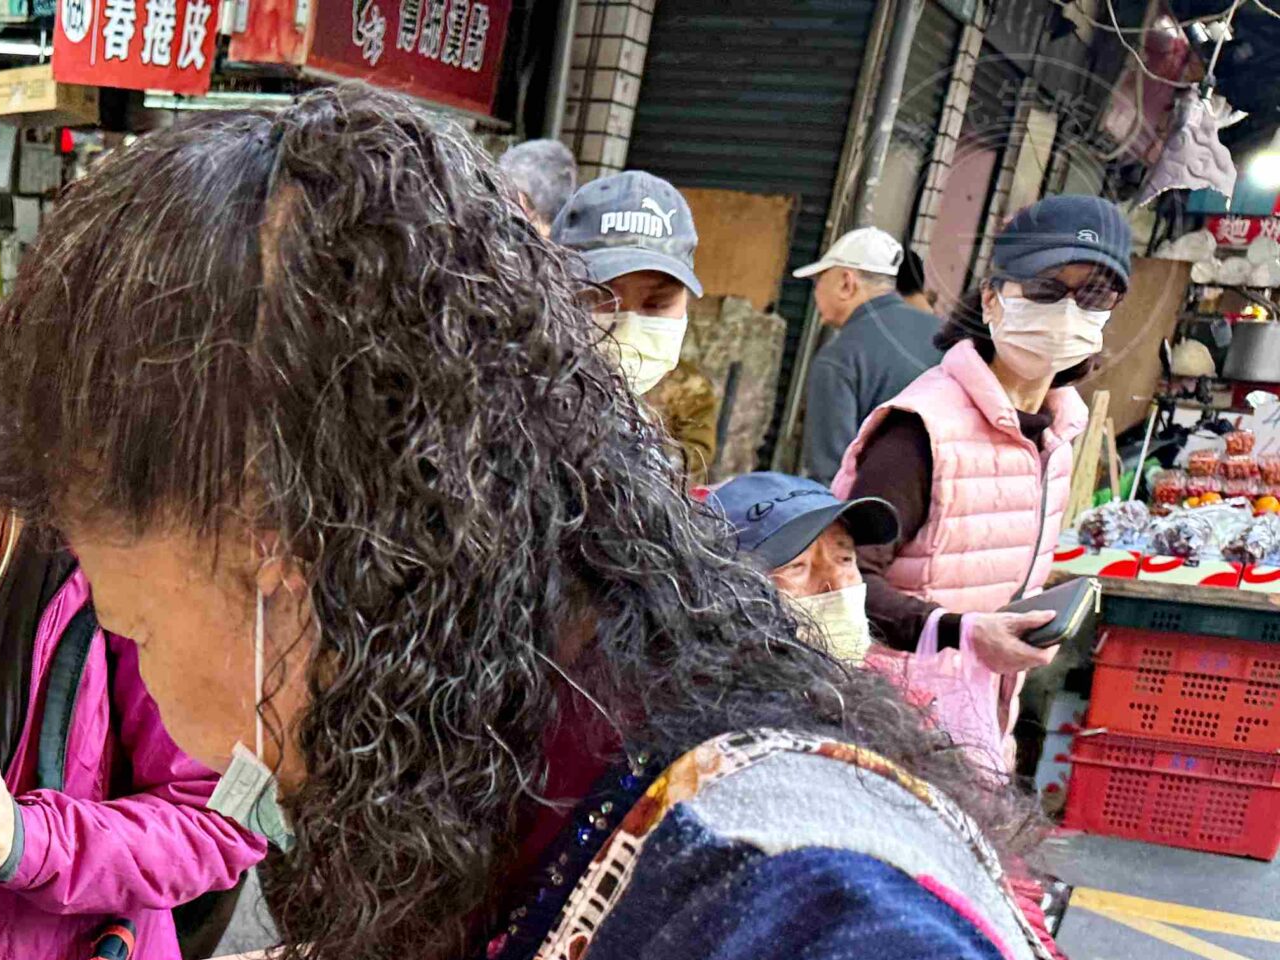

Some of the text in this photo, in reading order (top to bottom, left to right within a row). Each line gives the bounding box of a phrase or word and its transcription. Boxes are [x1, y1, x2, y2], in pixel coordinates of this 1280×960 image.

[103, 0, 213, 71] 春捲皮
[601, 211, 663, 238] PUMA
